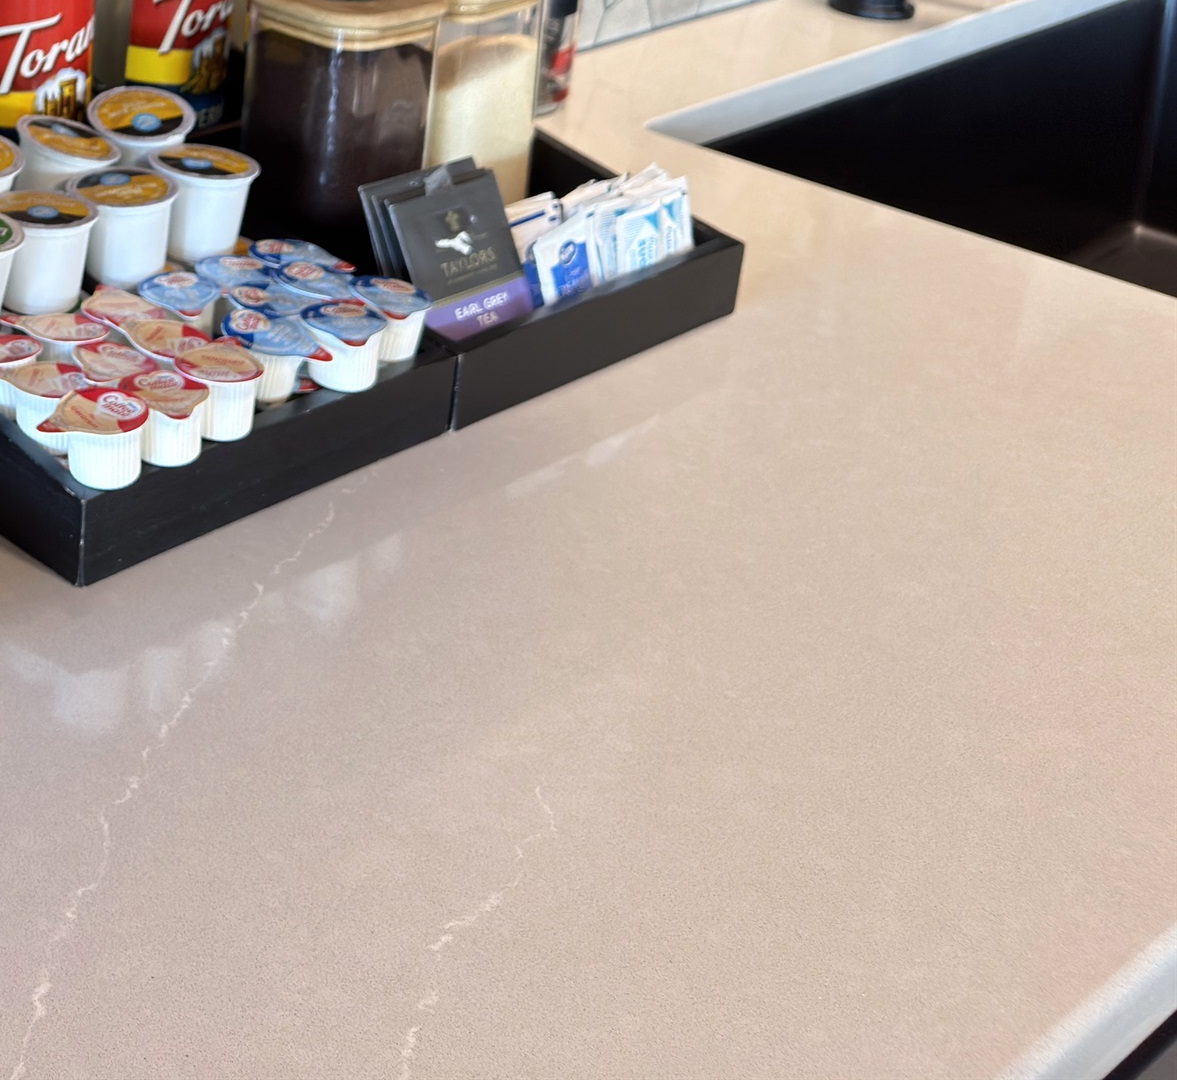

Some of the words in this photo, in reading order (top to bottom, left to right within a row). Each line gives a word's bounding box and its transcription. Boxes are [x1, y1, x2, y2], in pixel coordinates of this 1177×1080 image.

[455, 302, 483, 320] EARL
[483, 290, 508, 311] GREY
[476, 310, 499, 327] TEA
